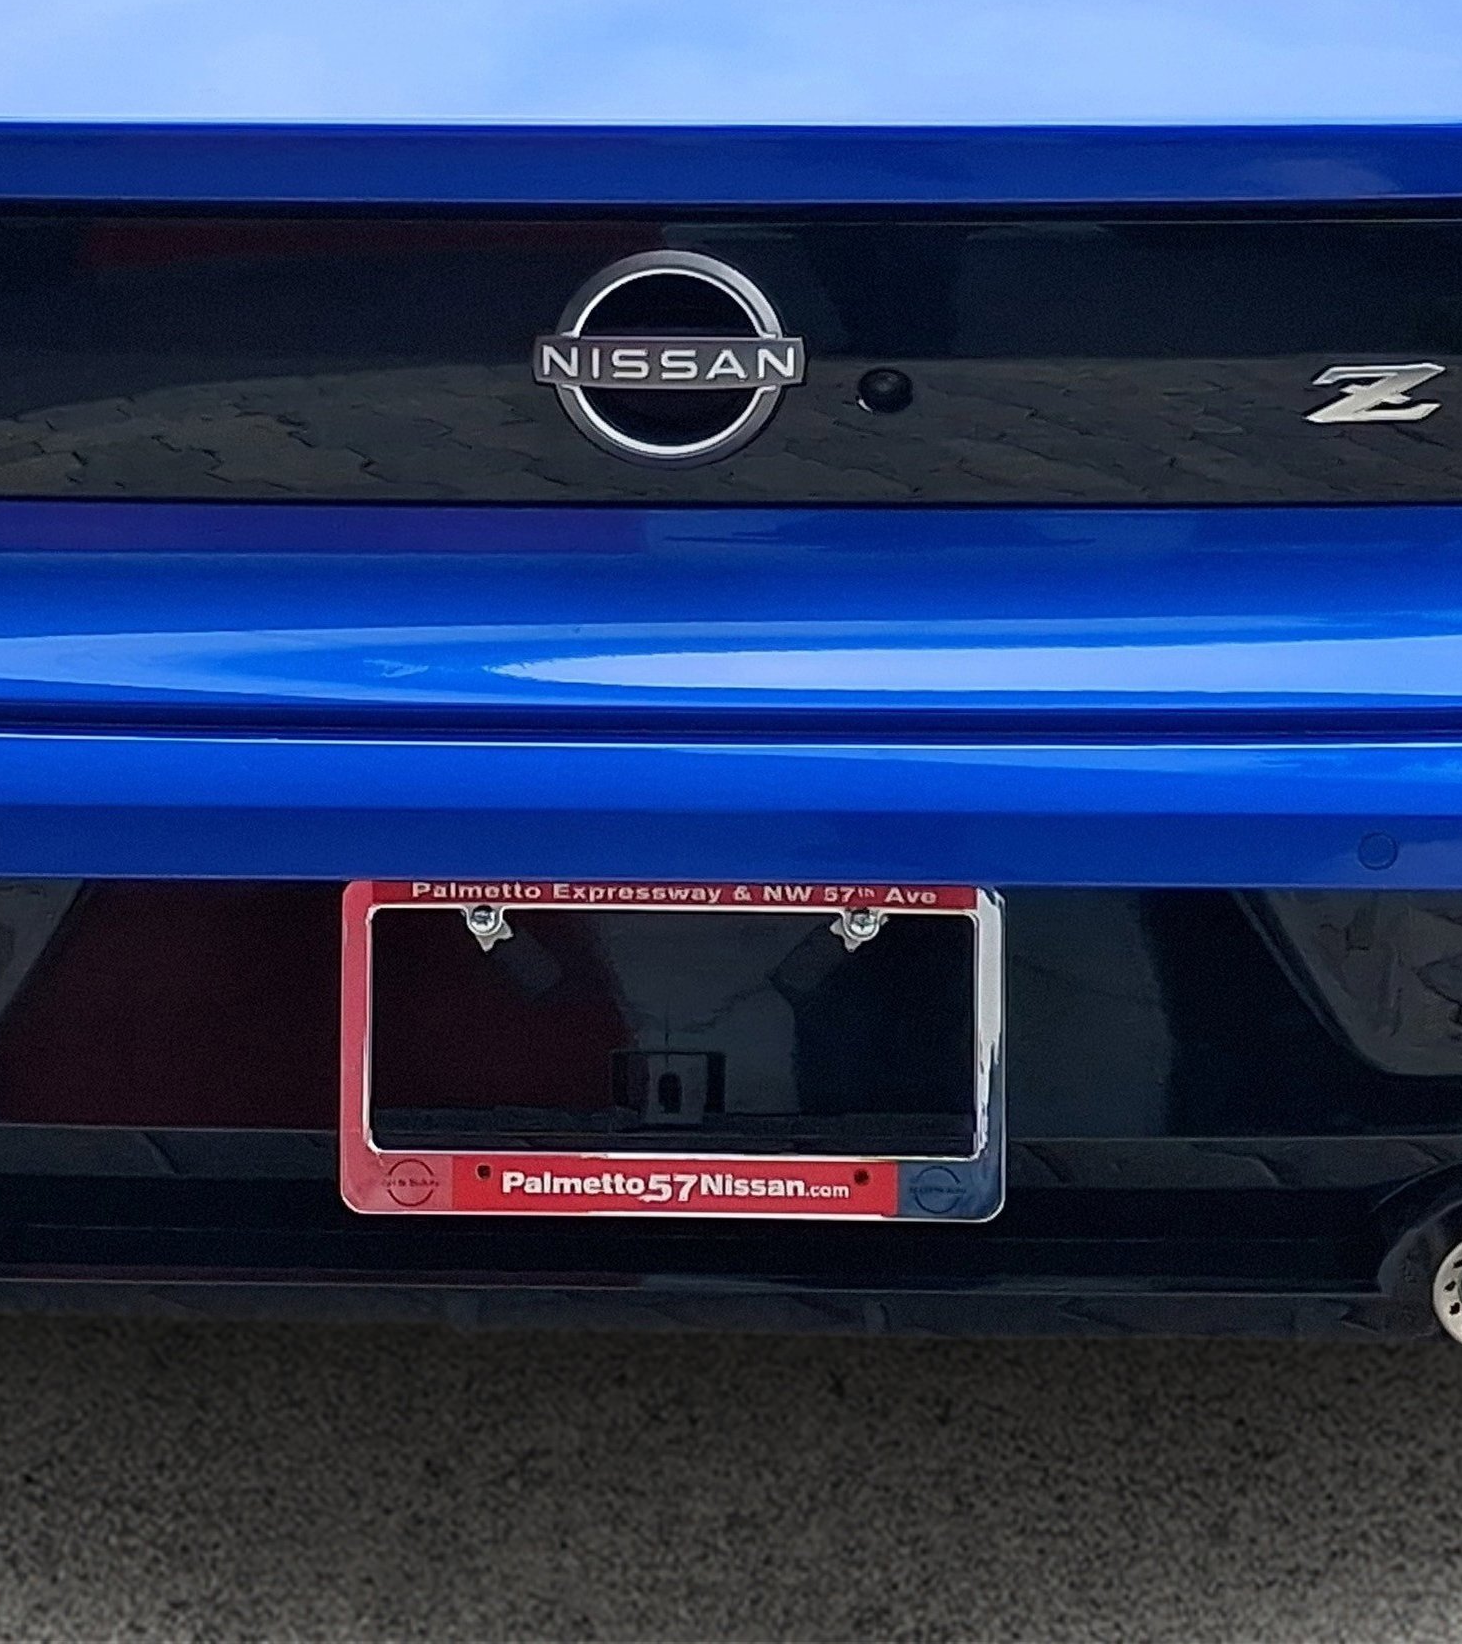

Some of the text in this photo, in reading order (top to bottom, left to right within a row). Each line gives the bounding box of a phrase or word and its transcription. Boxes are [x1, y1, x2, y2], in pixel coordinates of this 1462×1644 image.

[541, 344, 795, 381] NISSAN
[1305, 362, 1446, 423] Z
[412, 881, 938, 904] Palmetto Expressway & NW 57th Ave
[501, 1170, 851, 1204] Palmetto57Nissan.com
